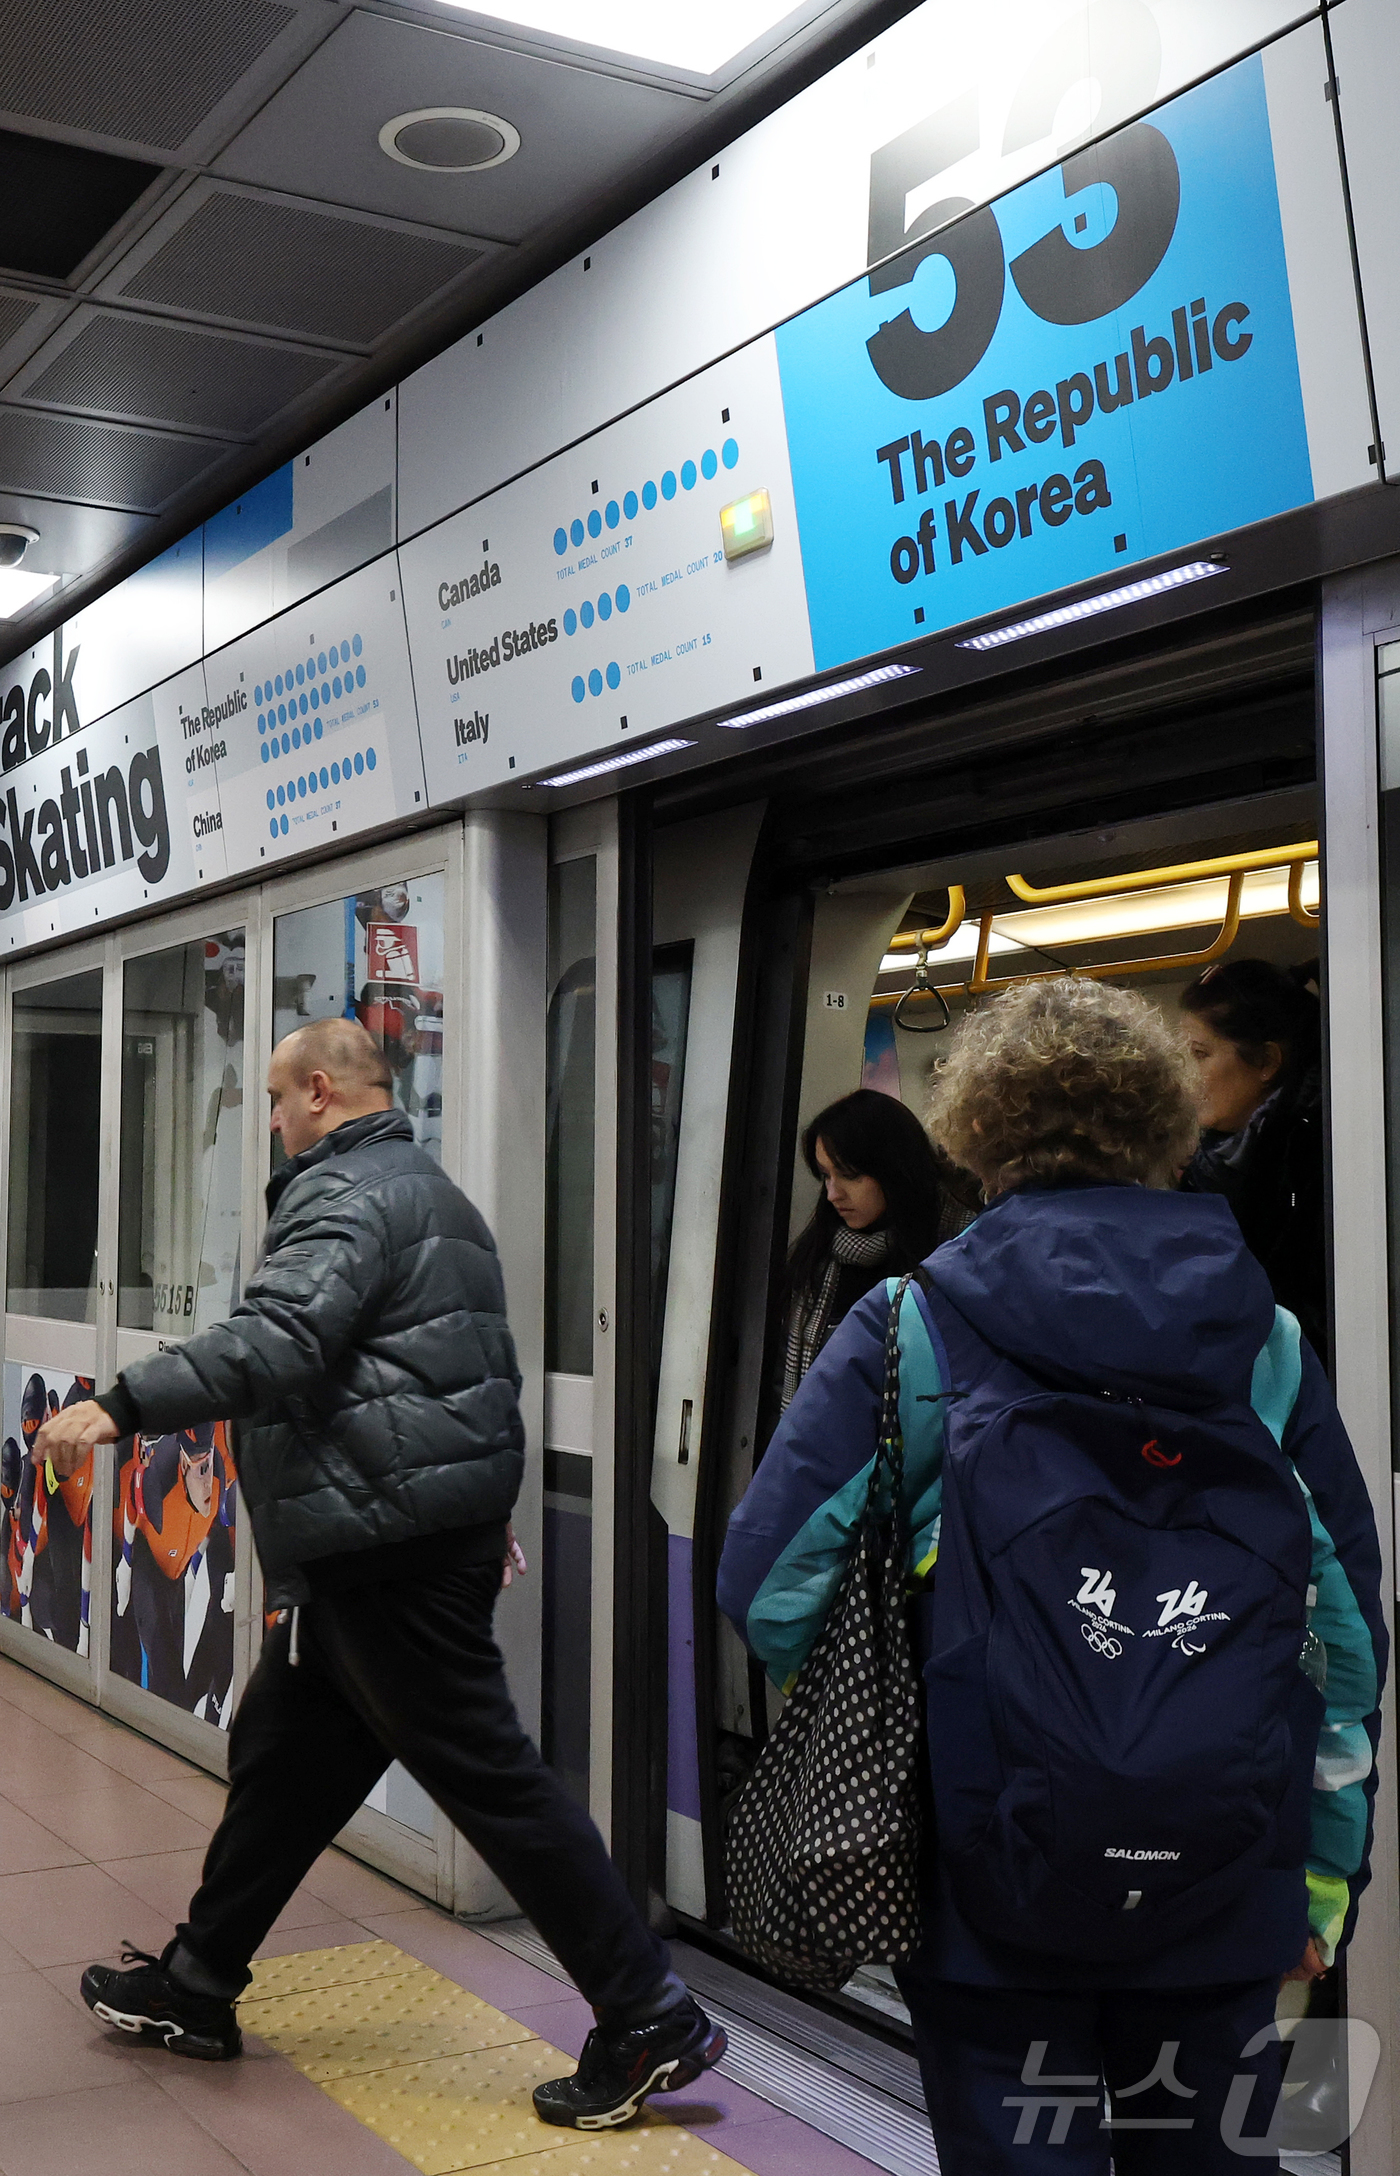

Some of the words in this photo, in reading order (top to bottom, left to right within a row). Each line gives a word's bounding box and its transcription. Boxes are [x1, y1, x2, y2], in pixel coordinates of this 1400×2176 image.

[866, 0, 1181, 401] 53
[877, 428, 976, 504] The
[982, 296, 1253, 464] Republic
[890, 512, 938, 585] of
[948, 459, 1112, 565] Korea
[556, 566, 576, 581] TOTAL
[578, 555, 598, 571] MEDAL
[600, 541, 621, 560] COUNT
[624, 535, 634, 549] 37
[636, 580, 658, 598] TOTAL
[661, 569, 684, 587] MEDAL
[686, 556, 709, 575] COUNT
[713, 550, 723, 564] 20
[438, 560, 502, 612] Canada
[446, 636, 501, 686] United
[502, 617, 559, 662] States
[626, 659, 648, 676] TOTAL
[650, 650, 673, 667] MEDAL
[675, 638, 698, 656] COUNT
[702, 633, 712, 646] 15
[0, 625, 81, 771] ack
[180, 714, 201, 740] The
[201, 689, 248, 729] Republic
[454, 710, 490, 747] Italy
[185, 749, 196, 774] of
[198, 740, 228, 769] Korea
[457, 752, 468, 764] ITA
[193, 811, 223, 838] China
[826, 993, 845, 1008] 1-8
[1067, 1599, 1097, 1622] MILANO
[1097, 1616, 1136, 1637] CORTINA
[1142, 1622, 1185, 1638] MILANO
[1186, 1612, 1231, 1627] CORTINA
[1176, 1624, 1198, 1636] 2026
[1104, 1848, 1181, 1861] SALOMON
